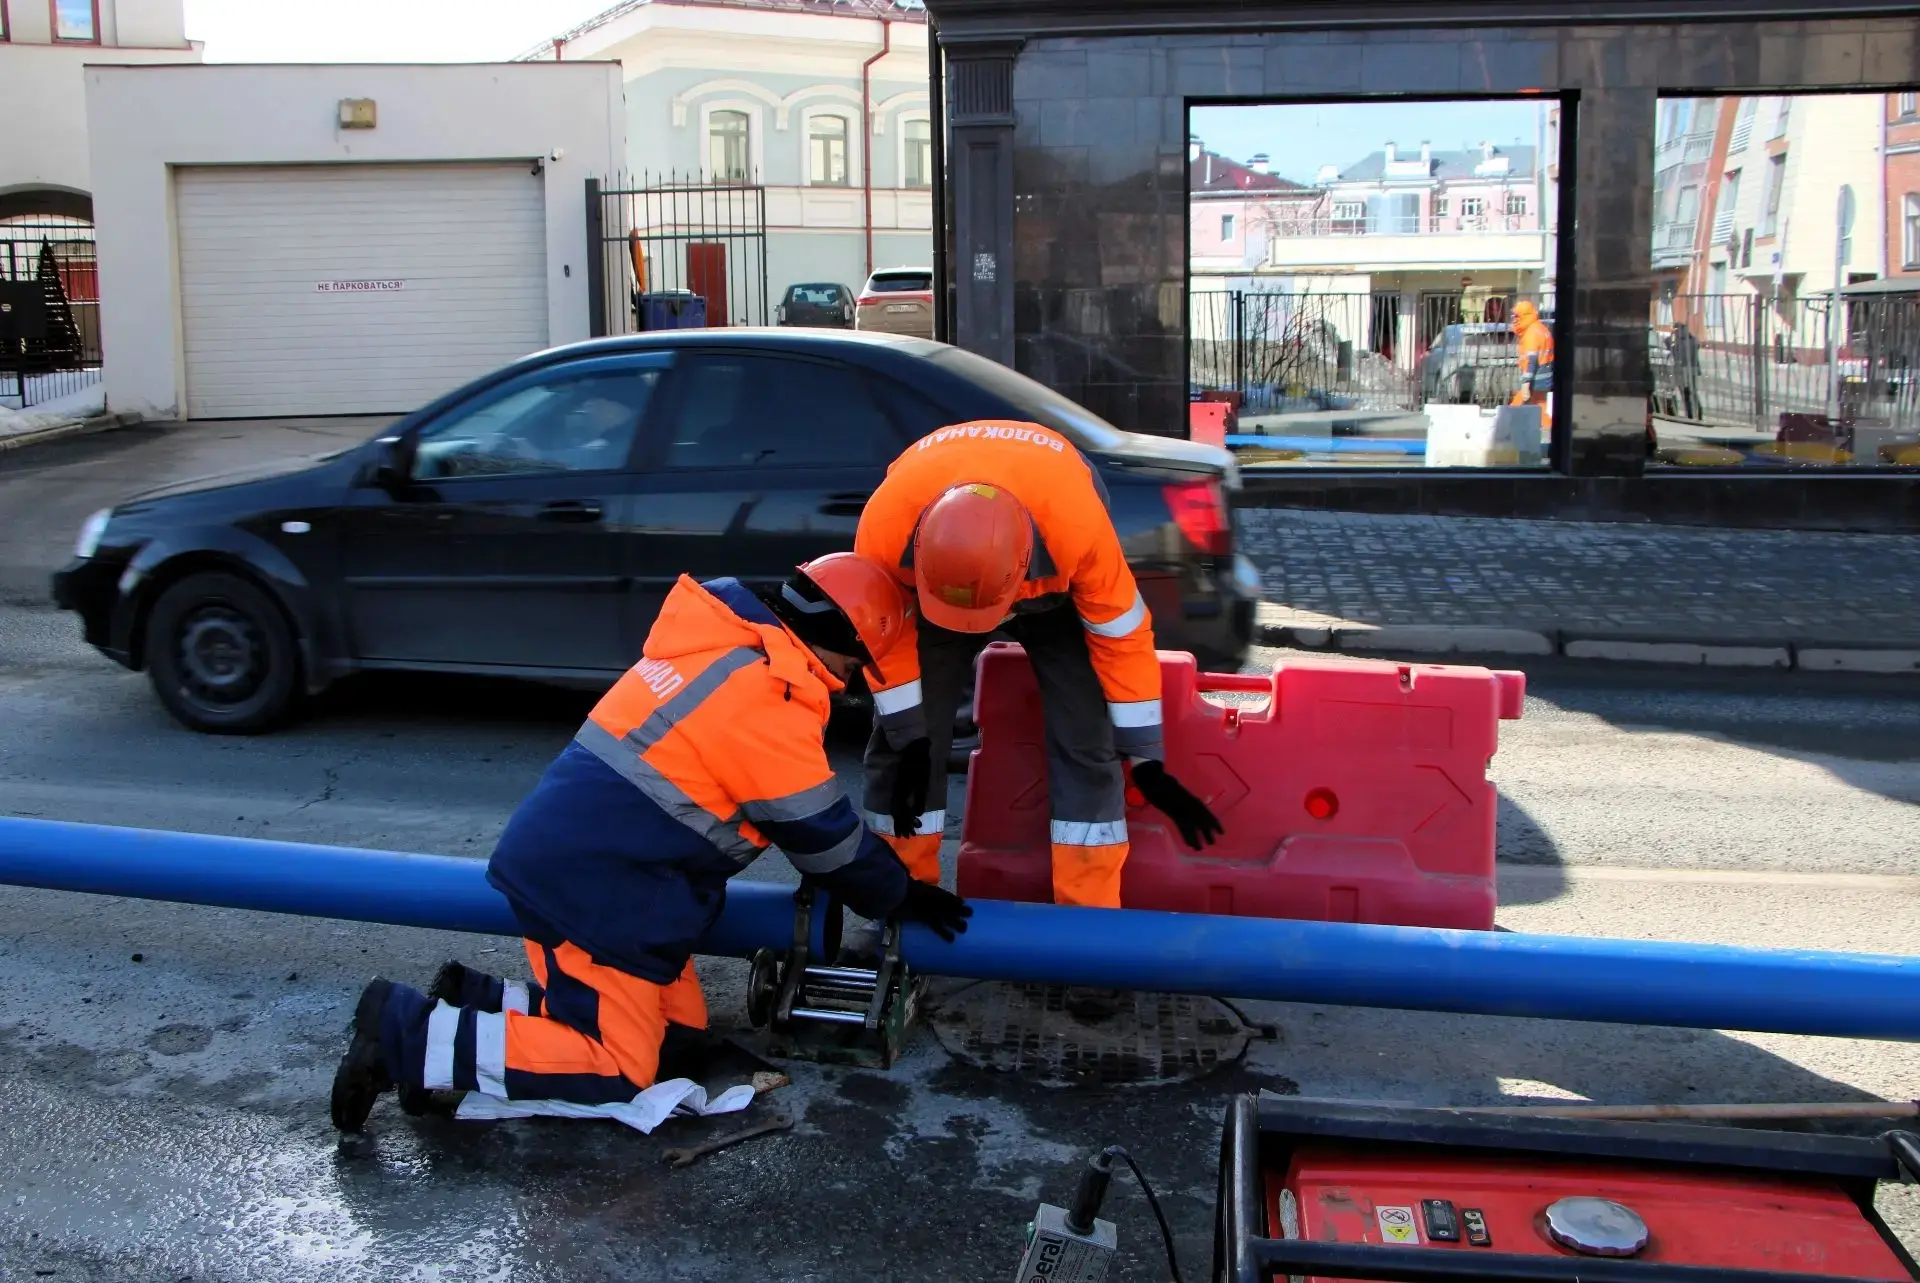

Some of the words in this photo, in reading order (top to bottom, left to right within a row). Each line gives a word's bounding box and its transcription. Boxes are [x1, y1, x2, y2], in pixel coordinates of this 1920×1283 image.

[318, 283, 330, 291] НЕ
[333, 281, 403, 290] ПАРКОВАТЬСЯ!
[917, 424, 1065, 452] ВОДОКАНАЛ
